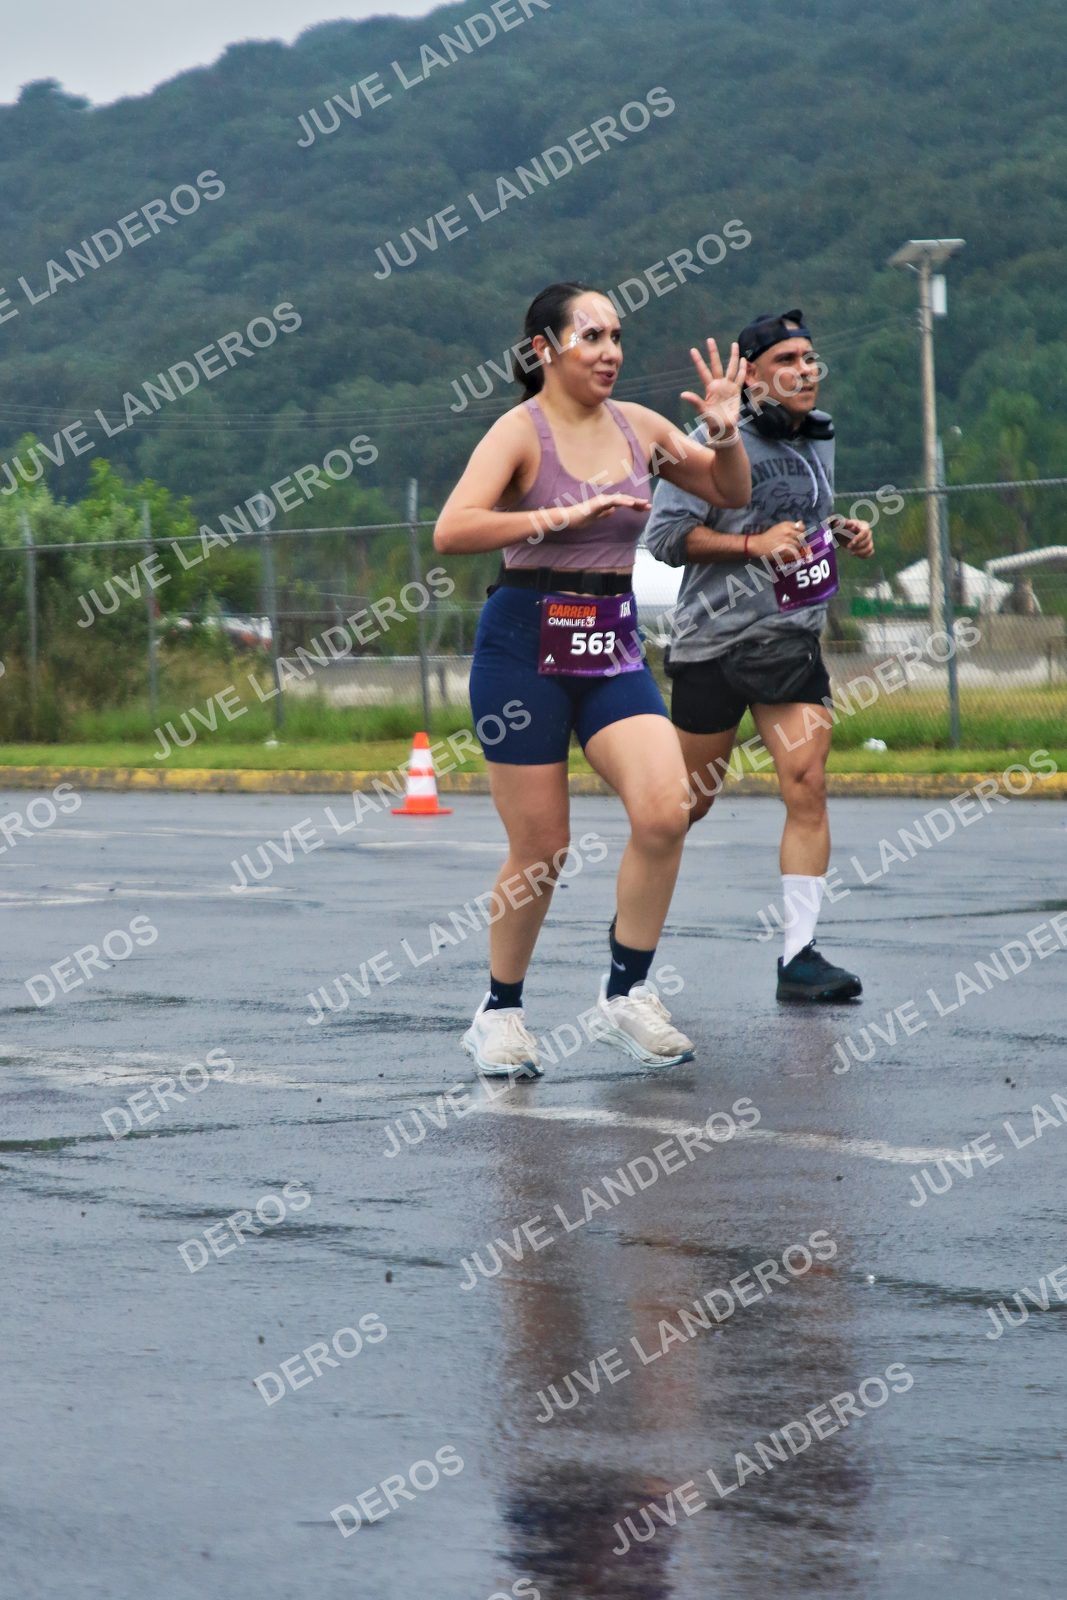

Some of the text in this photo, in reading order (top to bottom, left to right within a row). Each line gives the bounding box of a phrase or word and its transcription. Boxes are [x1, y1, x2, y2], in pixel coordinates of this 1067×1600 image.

[796, 559, 830, 588] 590
[548, 604, 597, 618] CARRERA
[570, 631, 615, 655] 563
